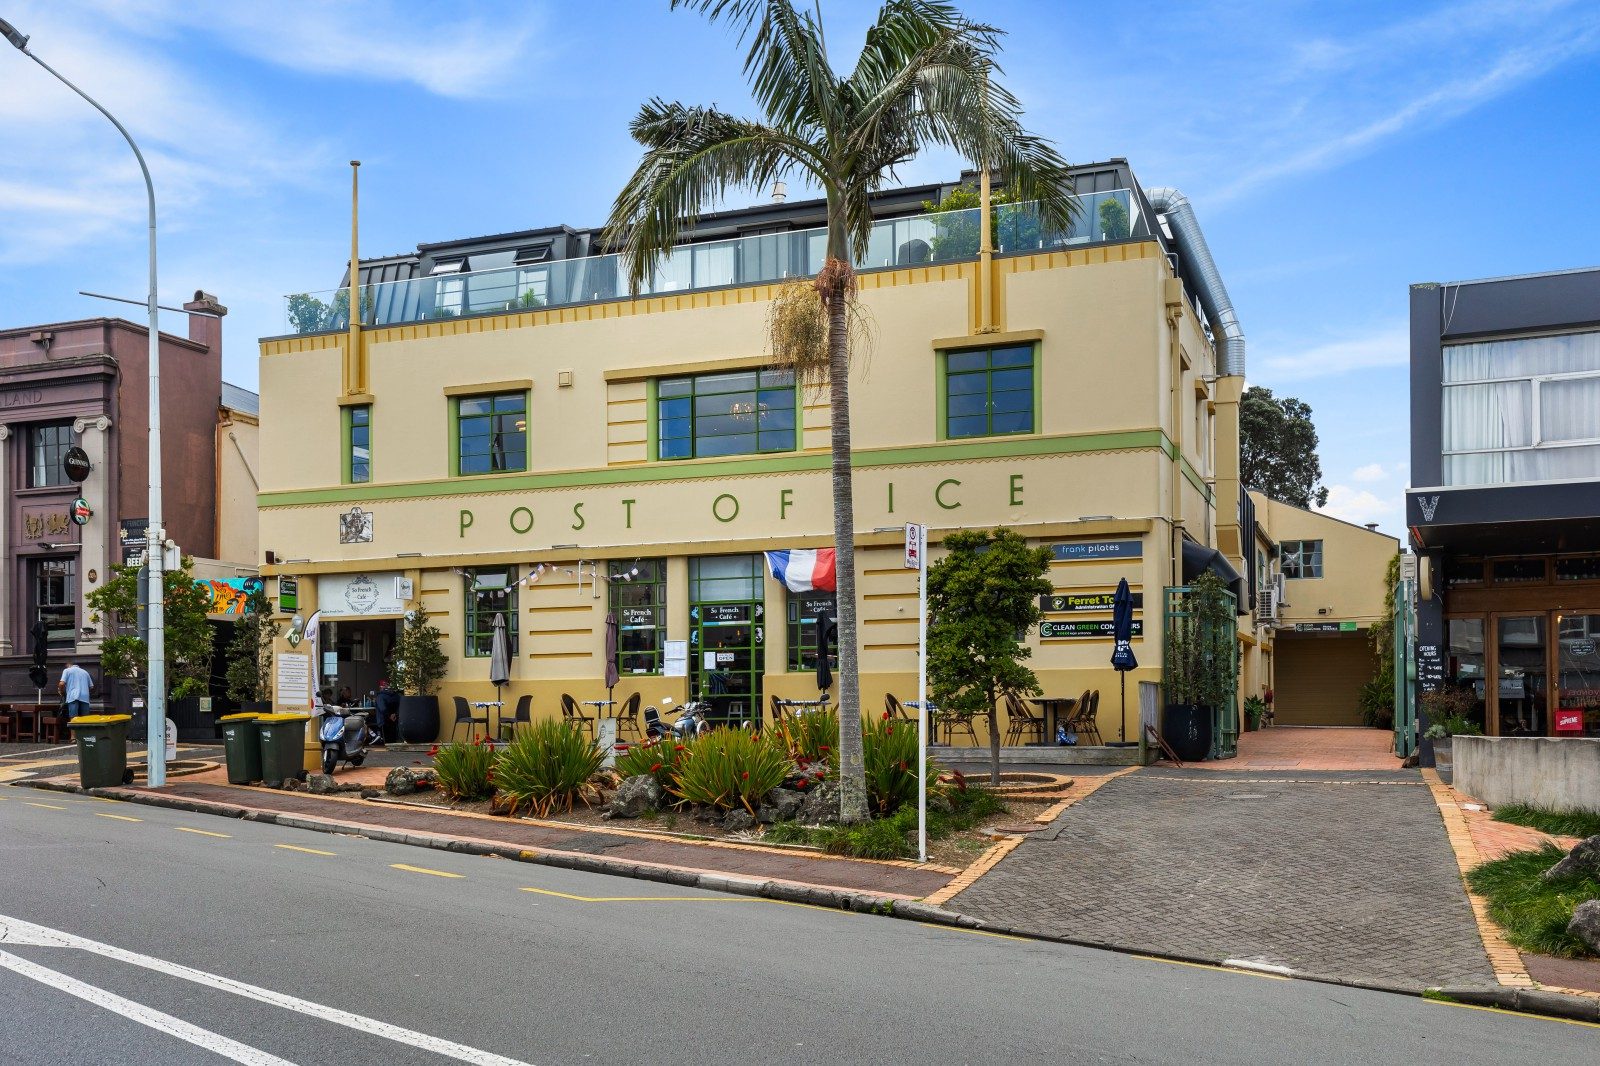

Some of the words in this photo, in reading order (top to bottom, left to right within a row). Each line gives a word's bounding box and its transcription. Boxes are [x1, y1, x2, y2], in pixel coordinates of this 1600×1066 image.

[459, 498, 636, 538] POST
[712, 474, 1024, 523] OFICE
[1417, 495, 1440, 521] V
[1062, 546, 1086, 554] frank
[1088, 544, 1120, 554] pilates
[1068, 596, 1100, 605] Ferret
[630, 608, 652, 616] French
[1052, 623, 1075, 631] CLEAN
[290, 634, 300, 644] 10
[1560, 717, 1579, 726] SUPREME
